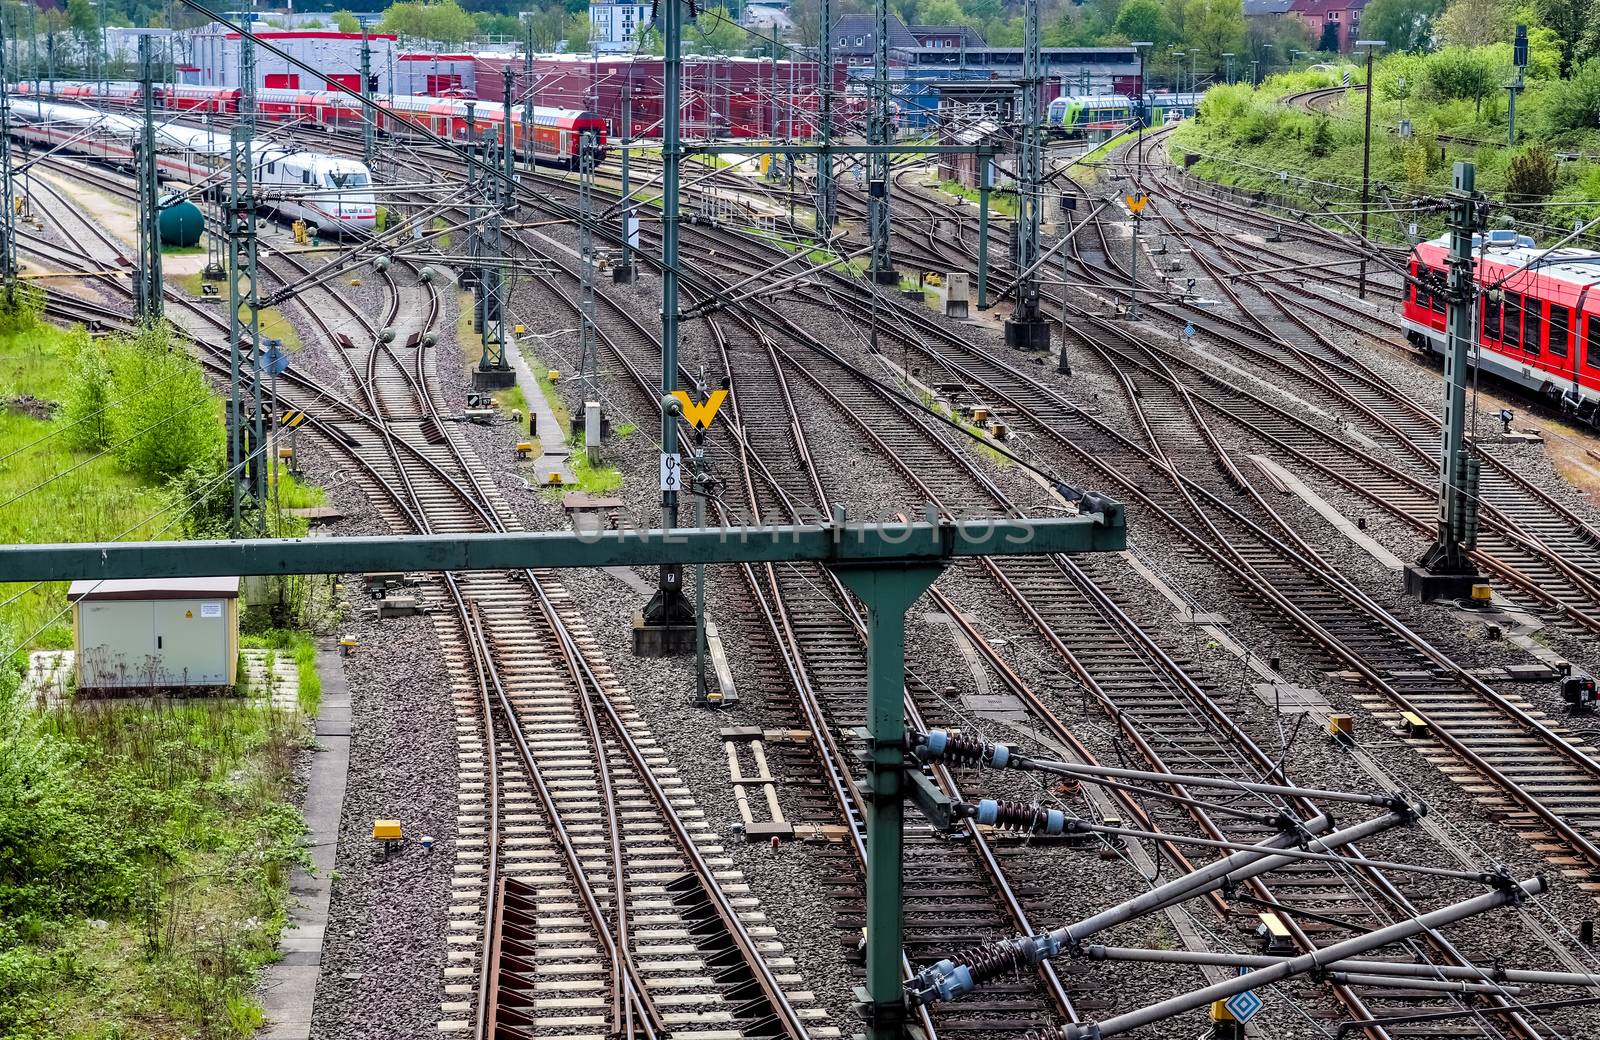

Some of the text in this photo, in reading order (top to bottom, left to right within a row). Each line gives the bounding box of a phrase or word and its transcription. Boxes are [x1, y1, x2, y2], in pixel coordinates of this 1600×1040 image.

[671, 390, 729, 430] W
[666, 471, 675, 486] 6
[668, 574, 674, 582] 7
